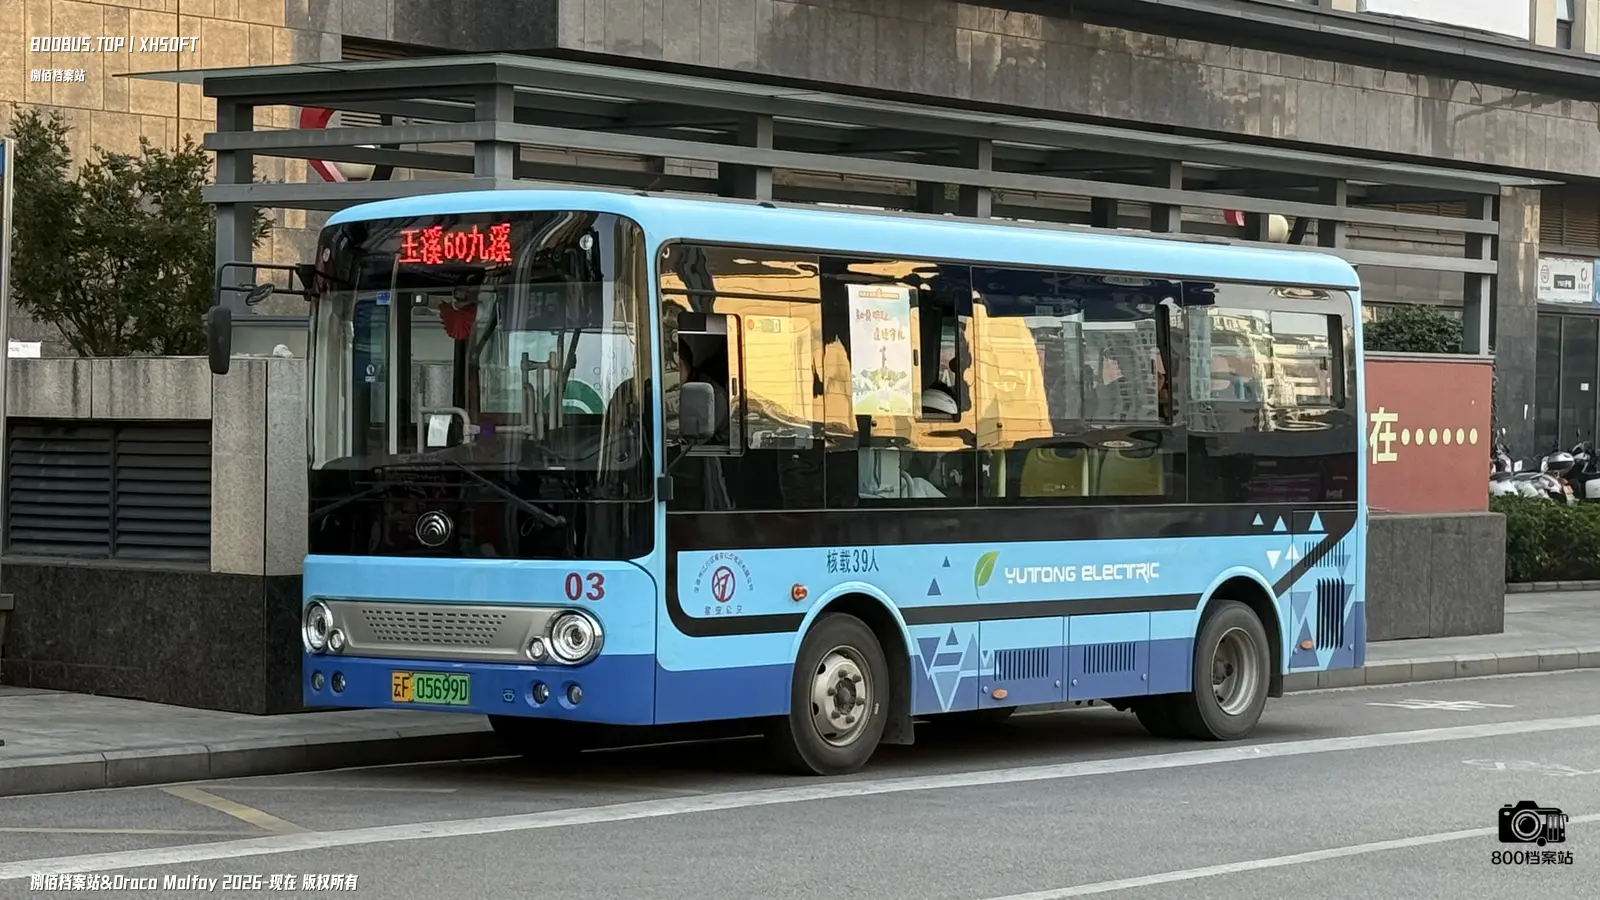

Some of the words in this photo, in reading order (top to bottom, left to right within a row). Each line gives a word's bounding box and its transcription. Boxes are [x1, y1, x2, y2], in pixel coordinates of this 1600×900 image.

[399, 223, 513, 264] 玉溪60九溪
[826, 549, 880, 574] 核载39人
[565, 572, 606, 601] 03
[1004, 566, 1077, 584] YUTONG
[393, 675, 411, 698] 云F
[416, 677, 468, 701] 05699D
